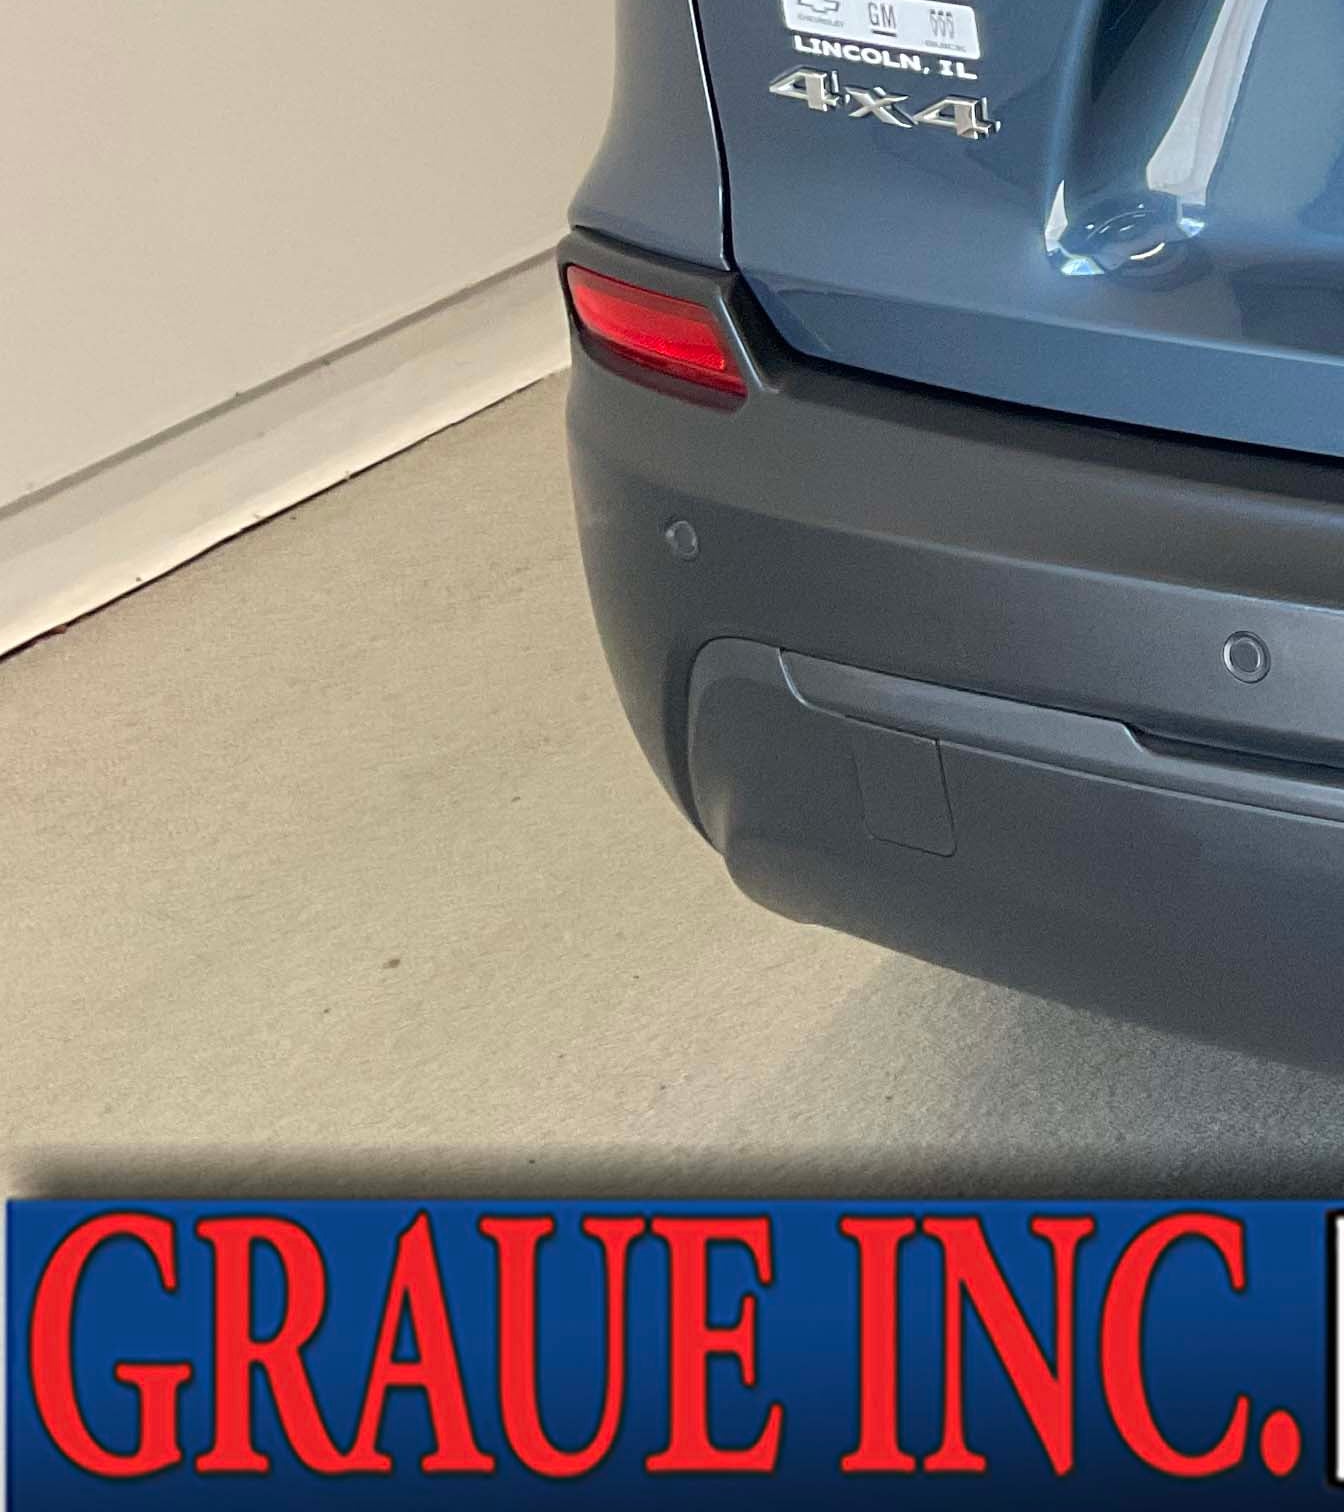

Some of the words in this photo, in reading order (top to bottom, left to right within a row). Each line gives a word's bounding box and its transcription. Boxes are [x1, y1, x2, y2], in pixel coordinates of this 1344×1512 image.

[867, 1, 897, 29] GM
[794, 35, 930, 75] LINCOLN,
[939, 59, 978, 80] IL
